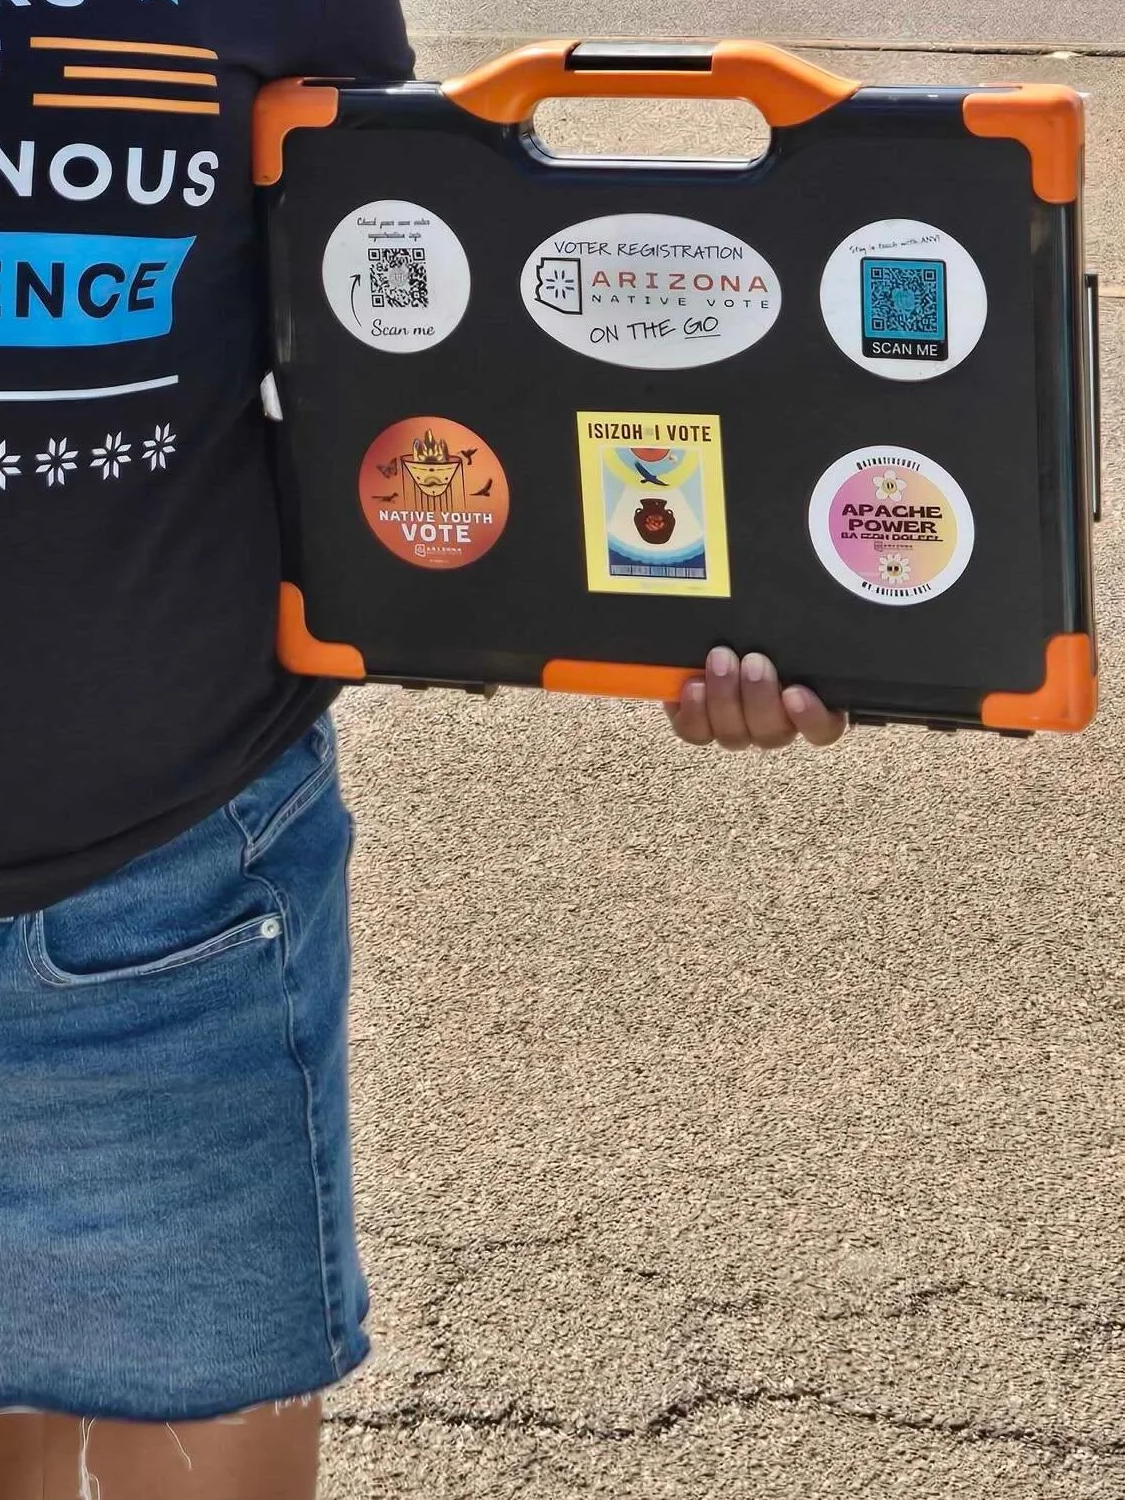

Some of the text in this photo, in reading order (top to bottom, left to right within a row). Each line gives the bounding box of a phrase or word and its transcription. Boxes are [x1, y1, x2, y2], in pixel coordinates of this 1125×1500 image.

[554, 240, 743, 260] VOTER REGISTRATION
[591, 269, 769, 294] ARIZONA
[591, 294, 770, 309] NATIVE VOTE
[371, 318, 436, 337] Scan me
[589, 316, 720, 345] ON THE GO
[872, 341, 938, 357] SCAN ME
[588, 422, 712, 442] ISIZOH I VOTE
[379, 510, 492, 524] NATIVE YOUTH
[841, 503, 943, 519] APACHE
[401, 523, 472, 543] VOTE
[848, 518, 938, 533] POWER
